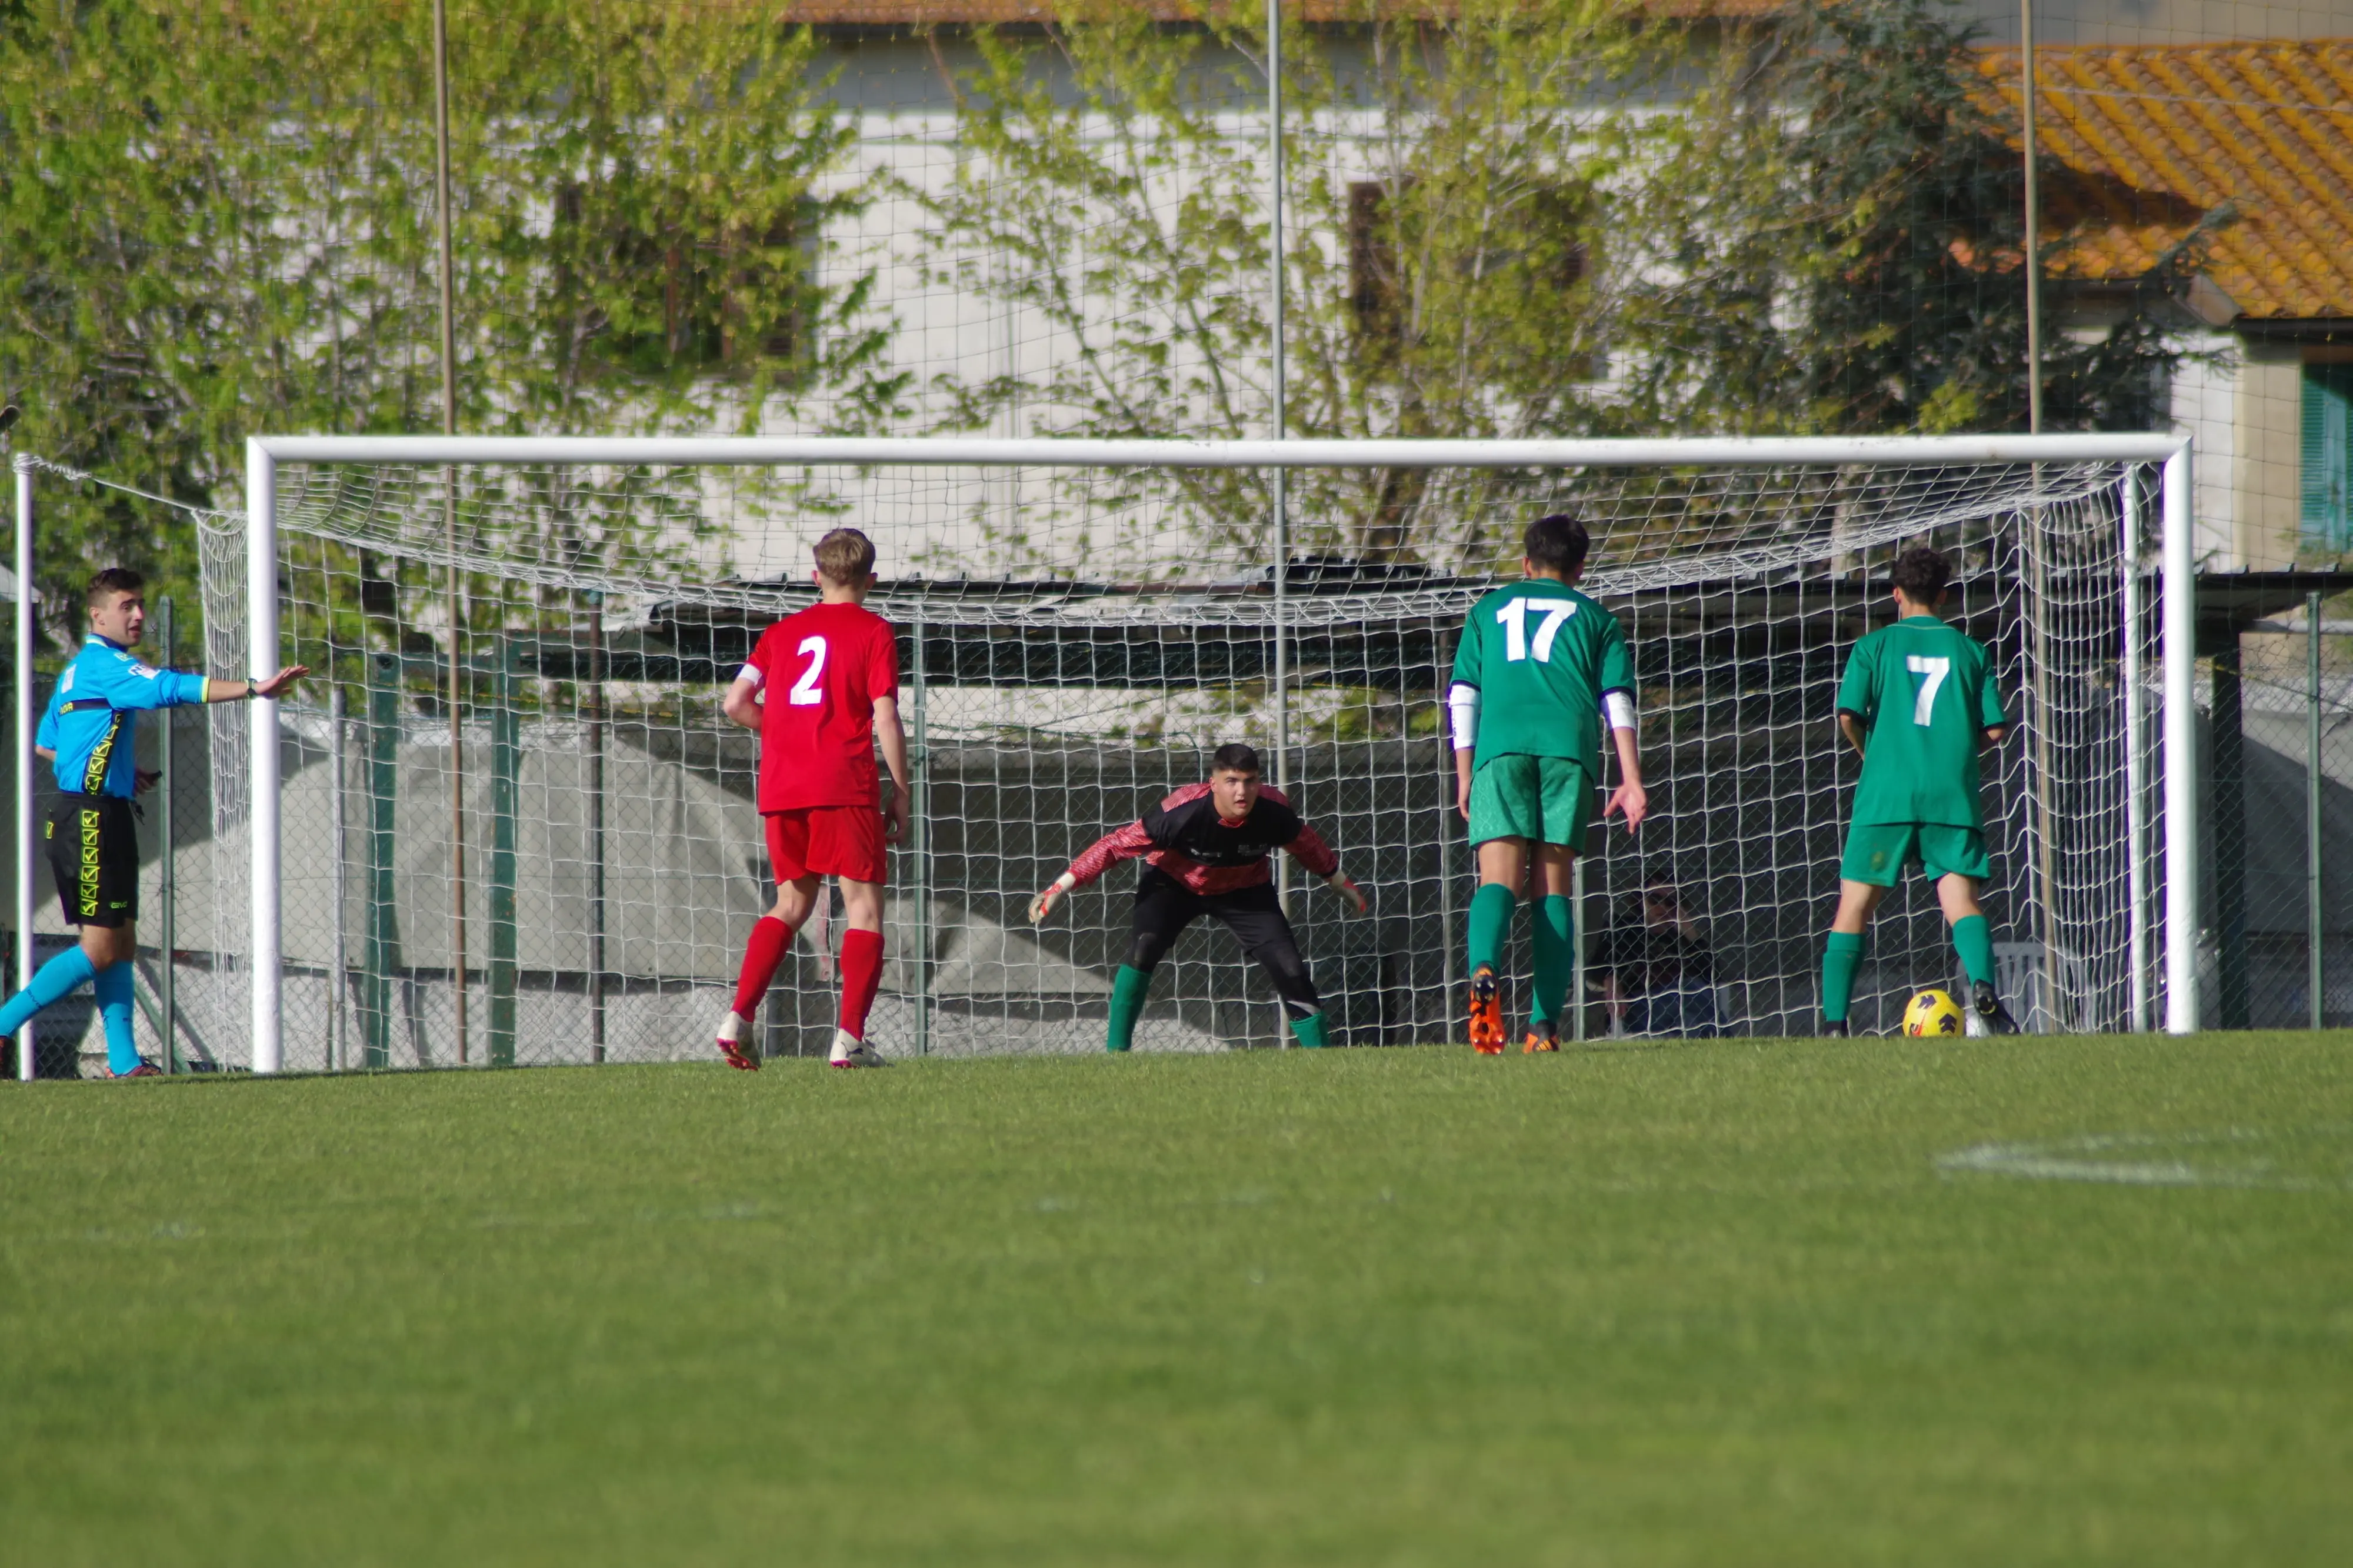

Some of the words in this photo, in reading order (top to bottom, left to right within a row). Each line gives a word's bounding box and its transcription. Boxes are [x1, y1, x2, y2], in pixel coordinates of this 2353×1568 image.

[1496, 596, 1578, 663] 17
[789, 635, 827, 706] 2
[1907, 655, 1950, 726] 7
